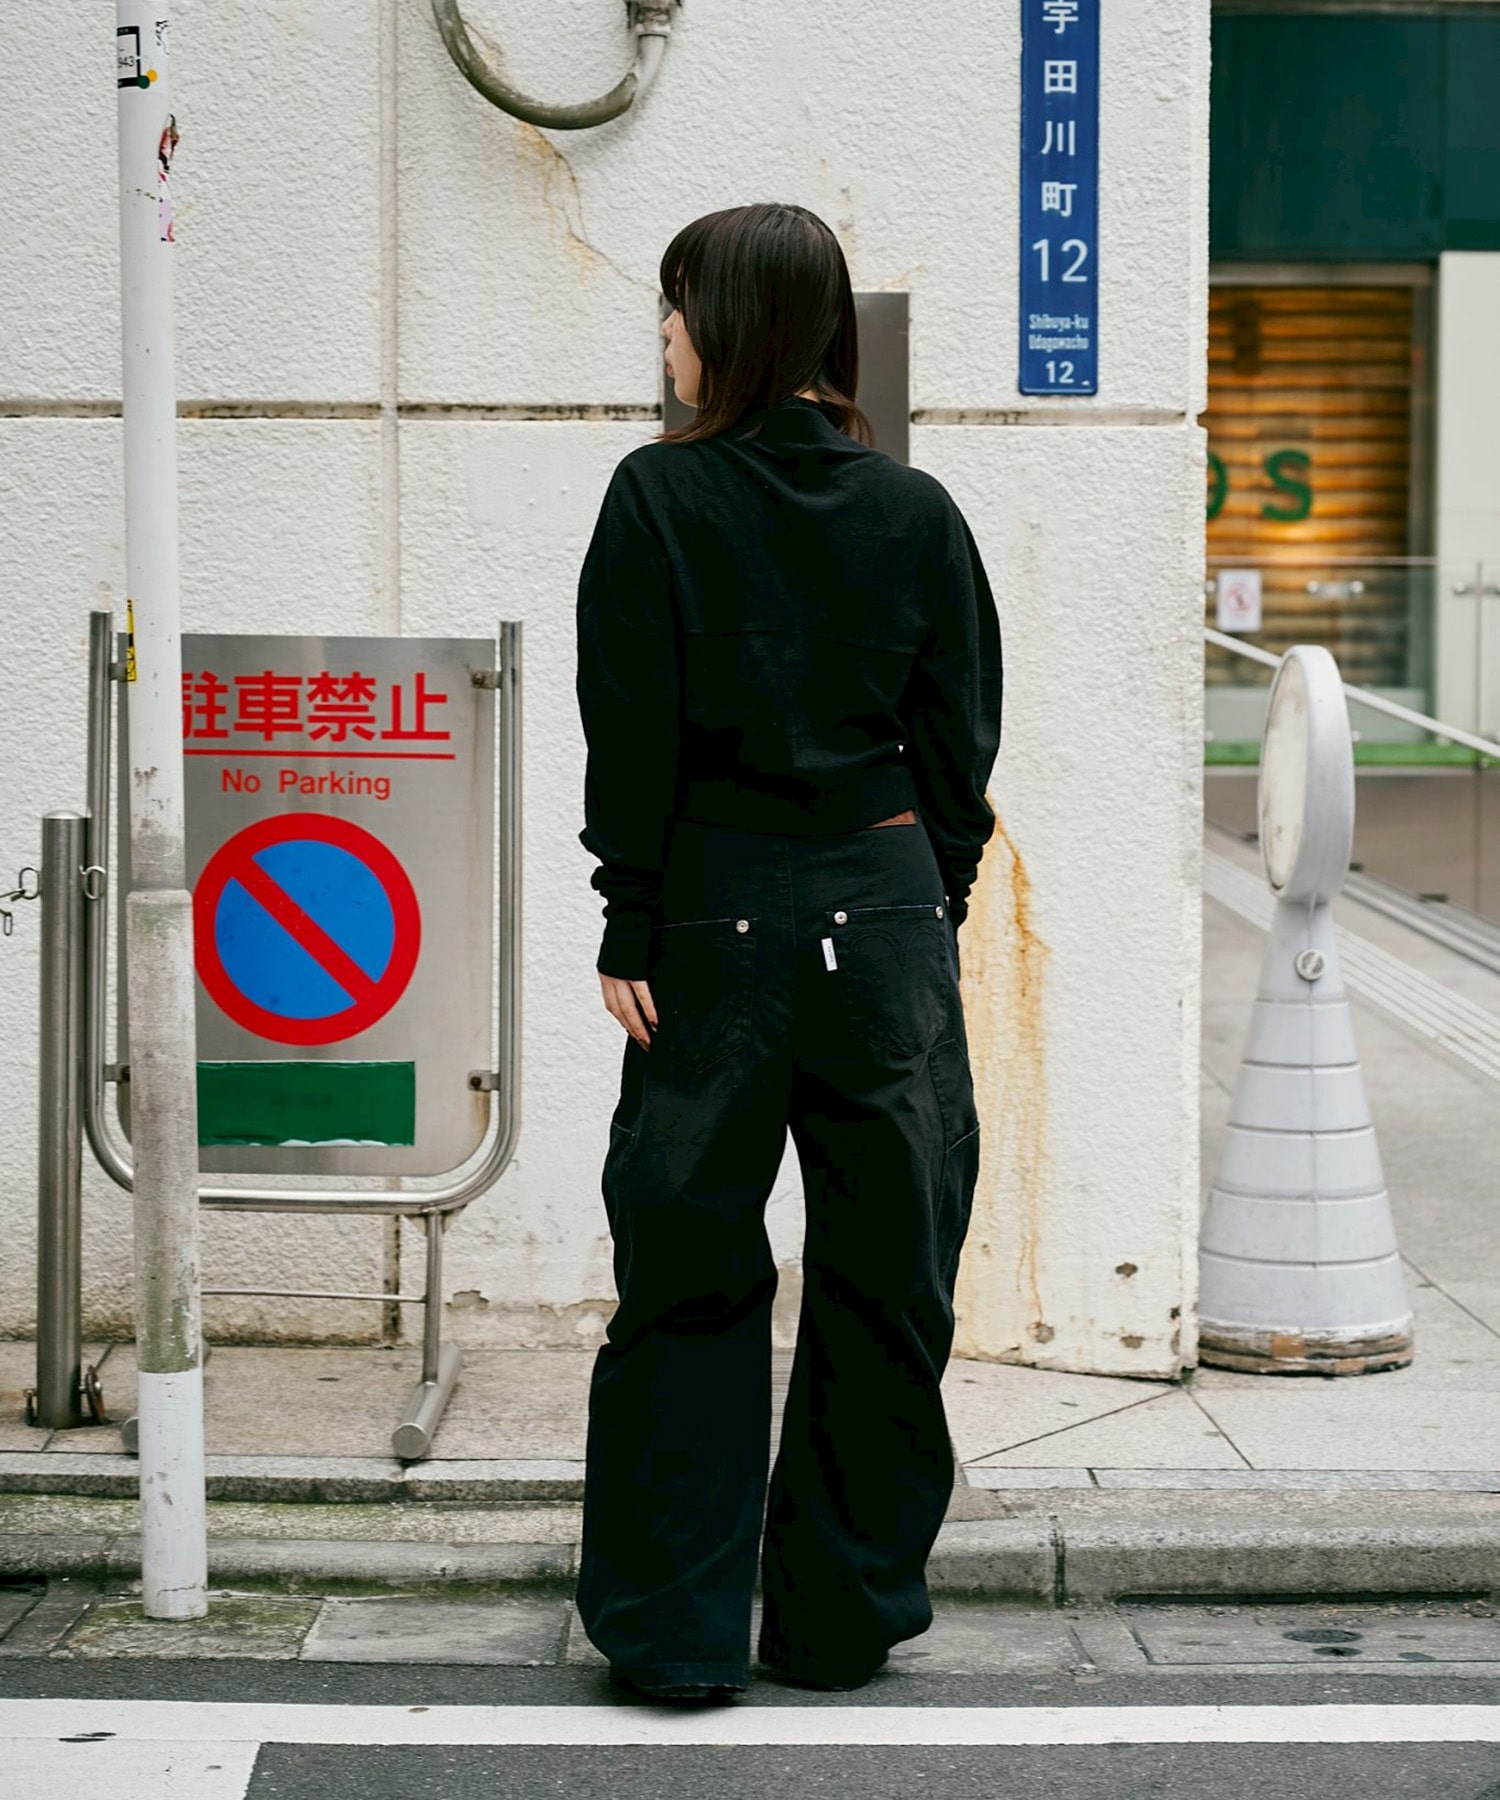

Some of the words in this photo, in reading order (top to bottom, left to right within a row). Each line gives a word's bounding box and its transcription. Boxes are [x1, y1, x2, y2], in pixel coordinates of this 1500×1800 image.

[1041, 0, 1080, 217] 宇田川町
[1032, 238, 1089, 282] 12
[1028, 313, 1089, 332] Shibuya-ku
[1045, 360, 1075, 383] 12
[181, 670, 451, 742] 駐車禁止
[221, 768, 261, 793] No
[278, 769, 391, 801] Parking
